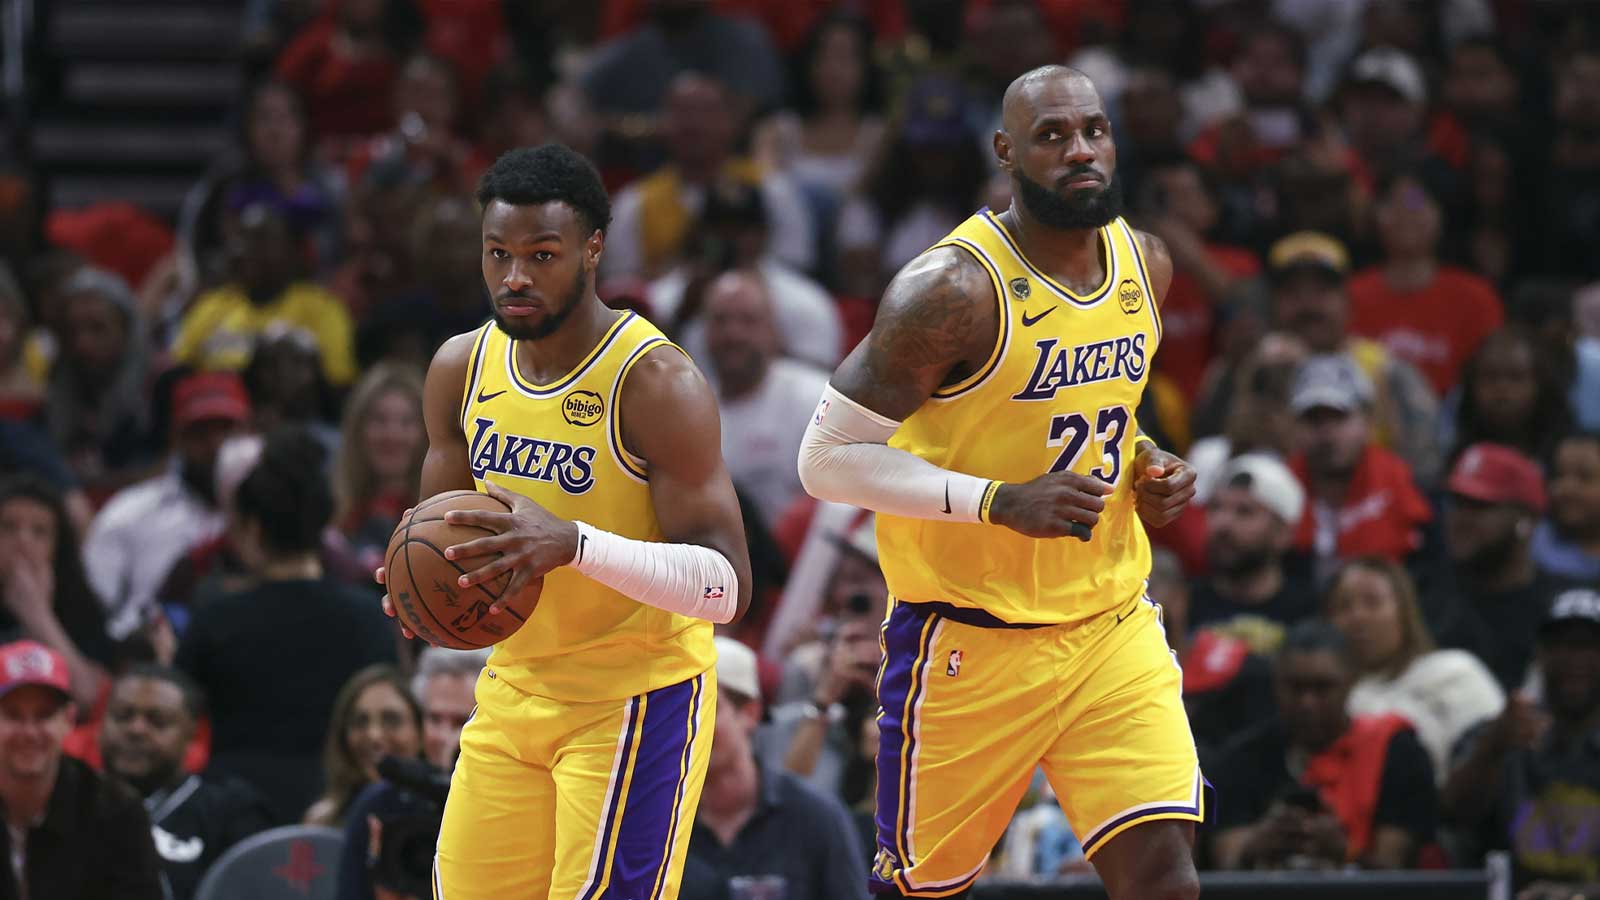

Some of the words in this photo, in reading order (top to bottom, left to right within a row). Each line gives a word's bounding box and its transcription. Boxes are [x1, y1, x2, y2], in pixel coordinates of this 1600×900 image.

[1010, 332, 1146, 401] LAKERS
[566, 398, 602, 417] bibigo
[469, 416, 598, 496] LAKERS
[1046, 405, 1129, 488] 23
